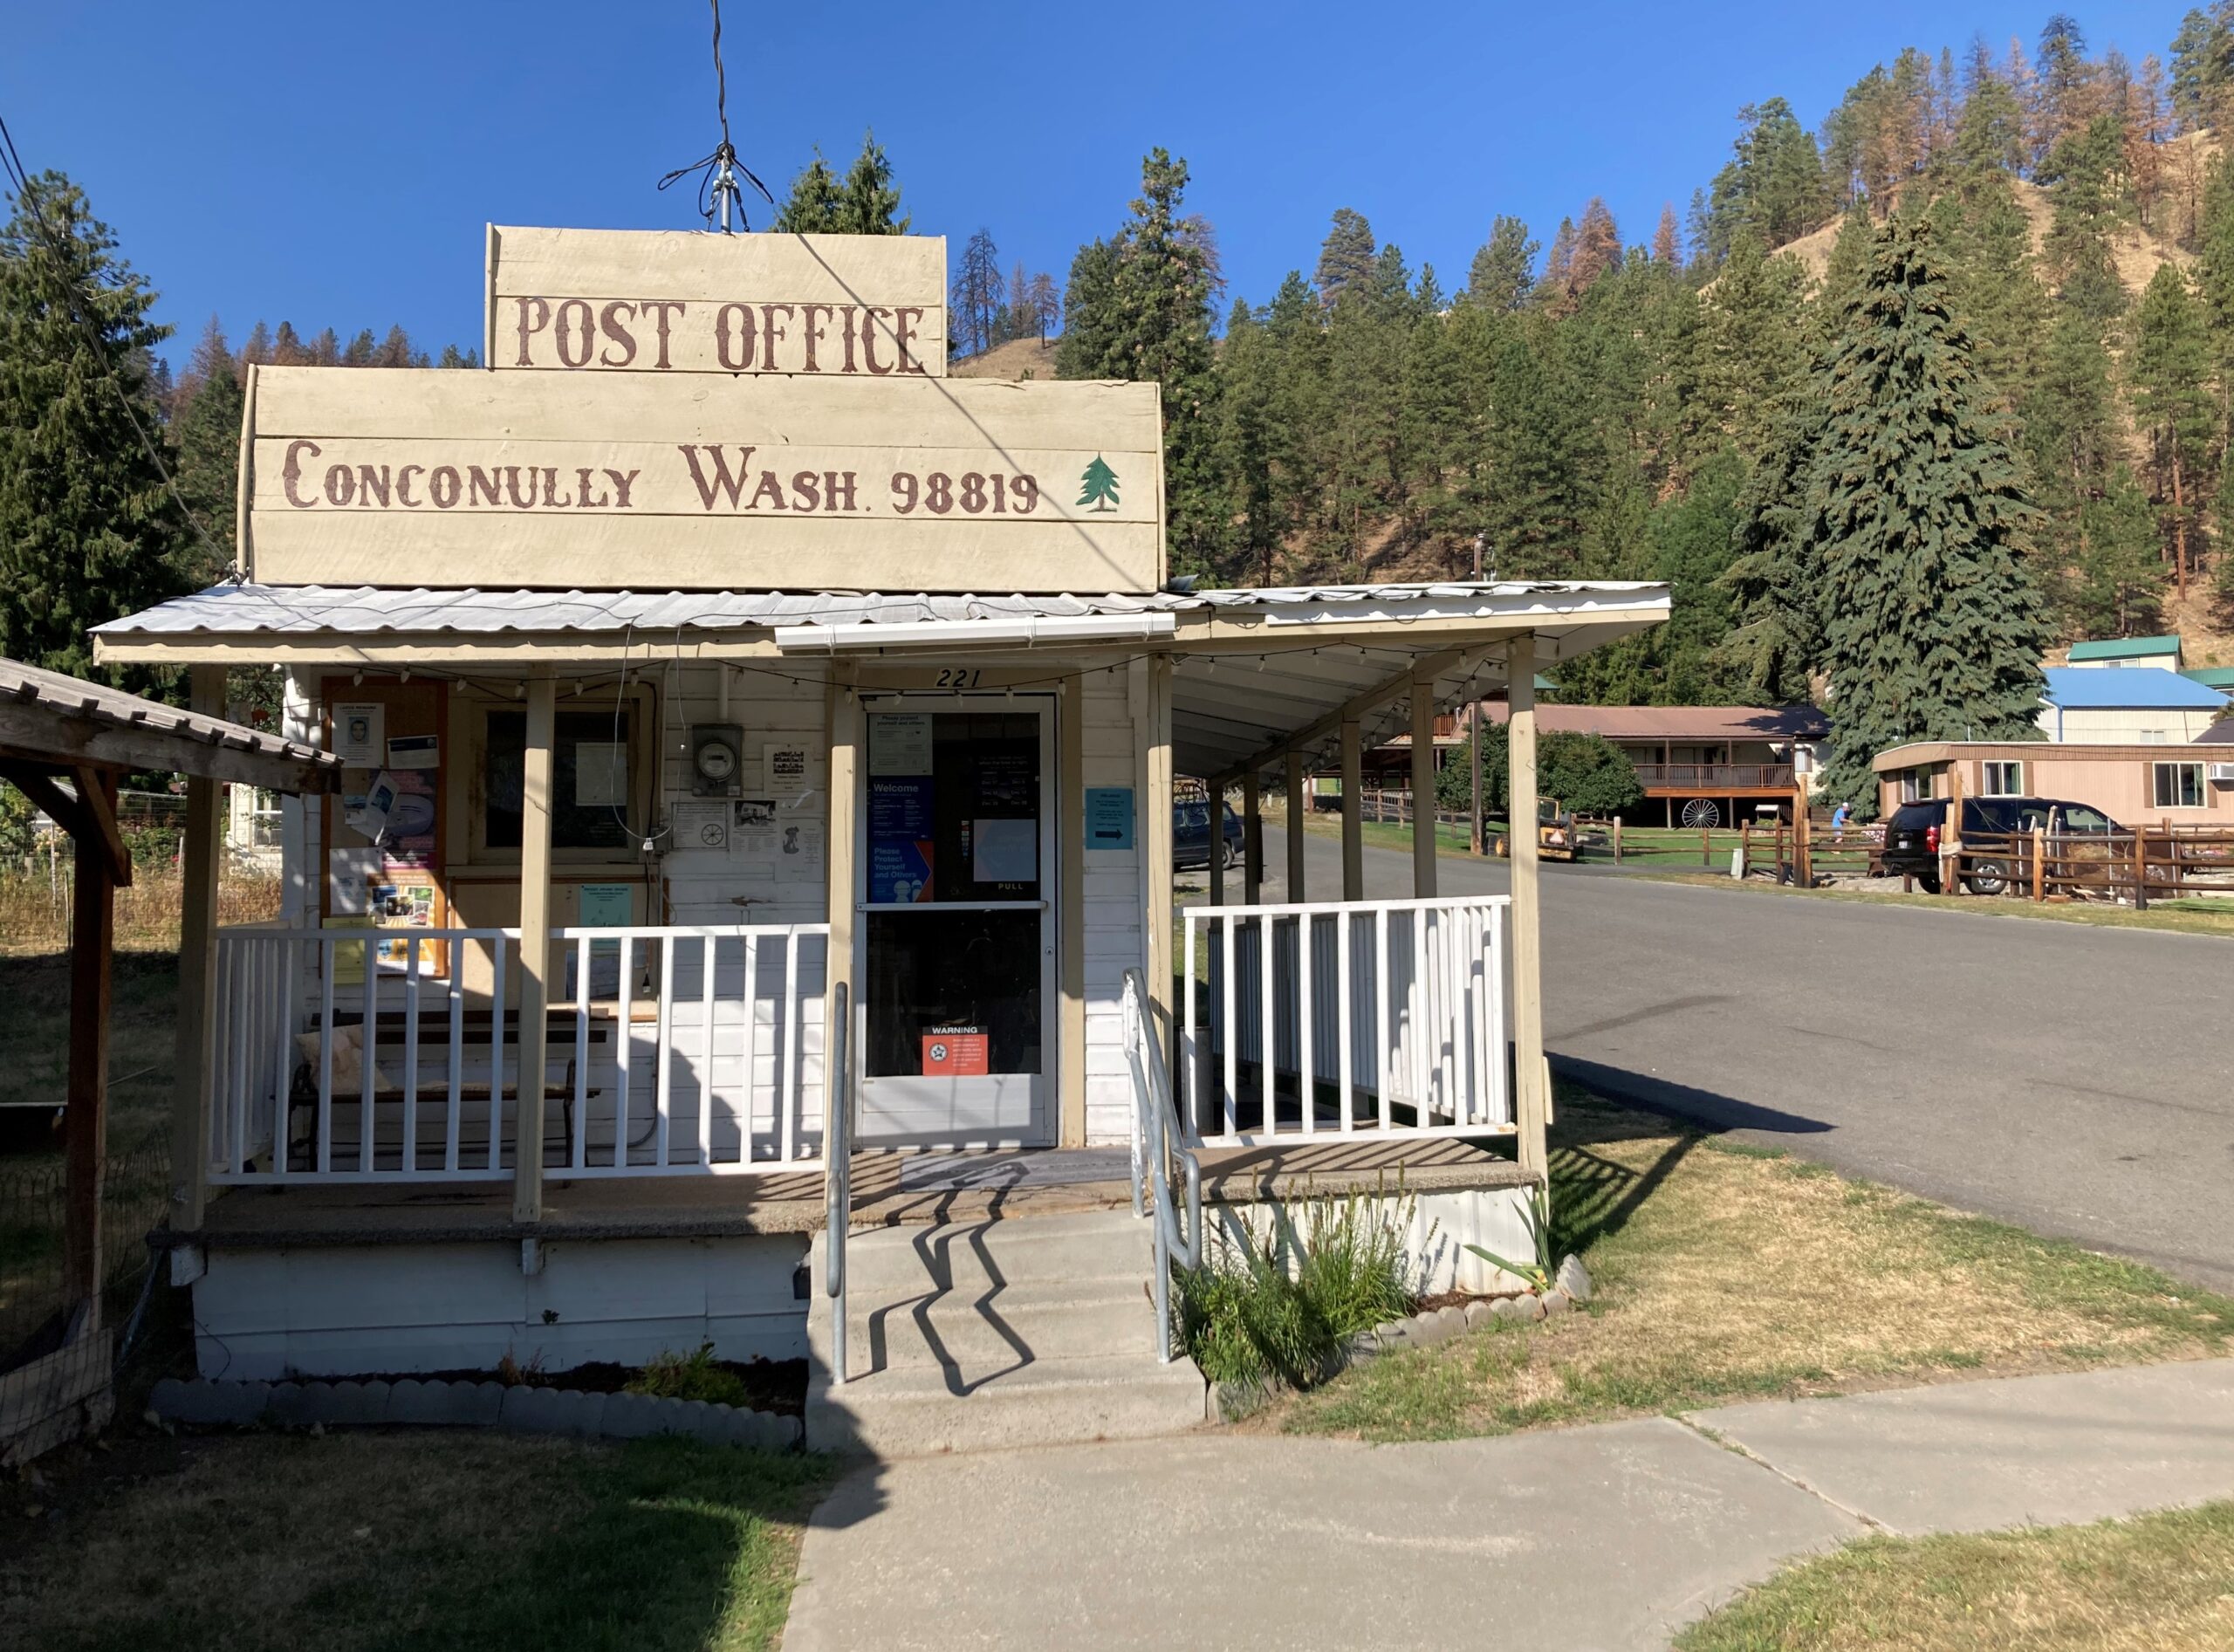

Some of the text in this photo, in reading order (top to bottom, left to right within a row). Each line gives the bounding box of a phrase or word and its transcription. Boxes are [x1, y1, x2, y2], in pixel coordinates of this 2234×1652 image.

[515, 298, 925, 375] POST OFFICE
[282, 440, 641, 509] CONCONULLY
[891, 471, 1040, 515] 98819
[936, 668, 981, 688] 221
[874, 784, 919, 793] Welcome
